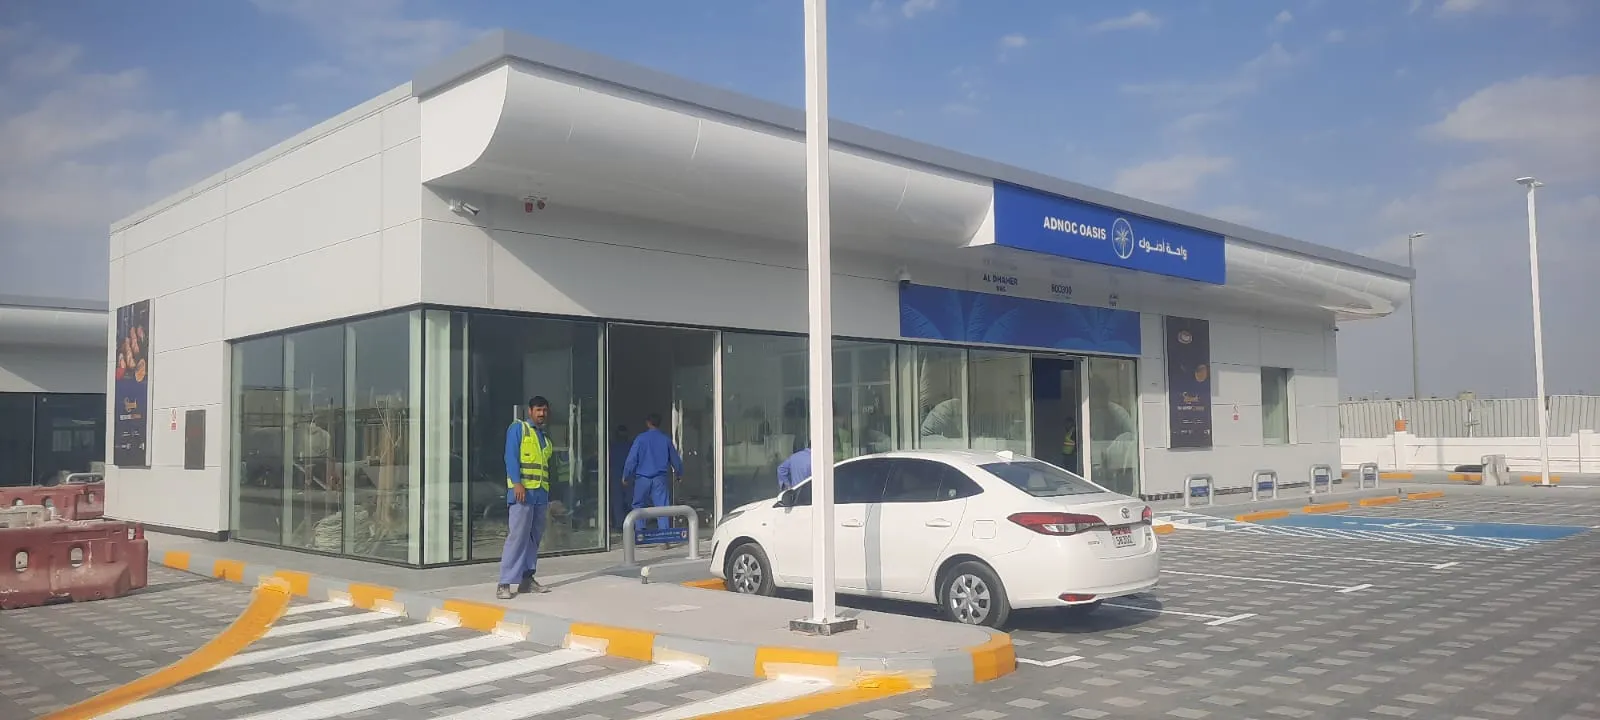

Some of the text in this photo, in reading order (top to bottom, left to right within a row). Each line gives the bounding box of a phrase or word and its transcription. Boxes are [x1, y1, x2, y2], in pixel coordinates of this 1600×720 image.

[1043, 216, 1107, 241] ADNOC OASIS
[1166, 242, 1188, 260] واحة
[983, 273, 991, 282] AL
